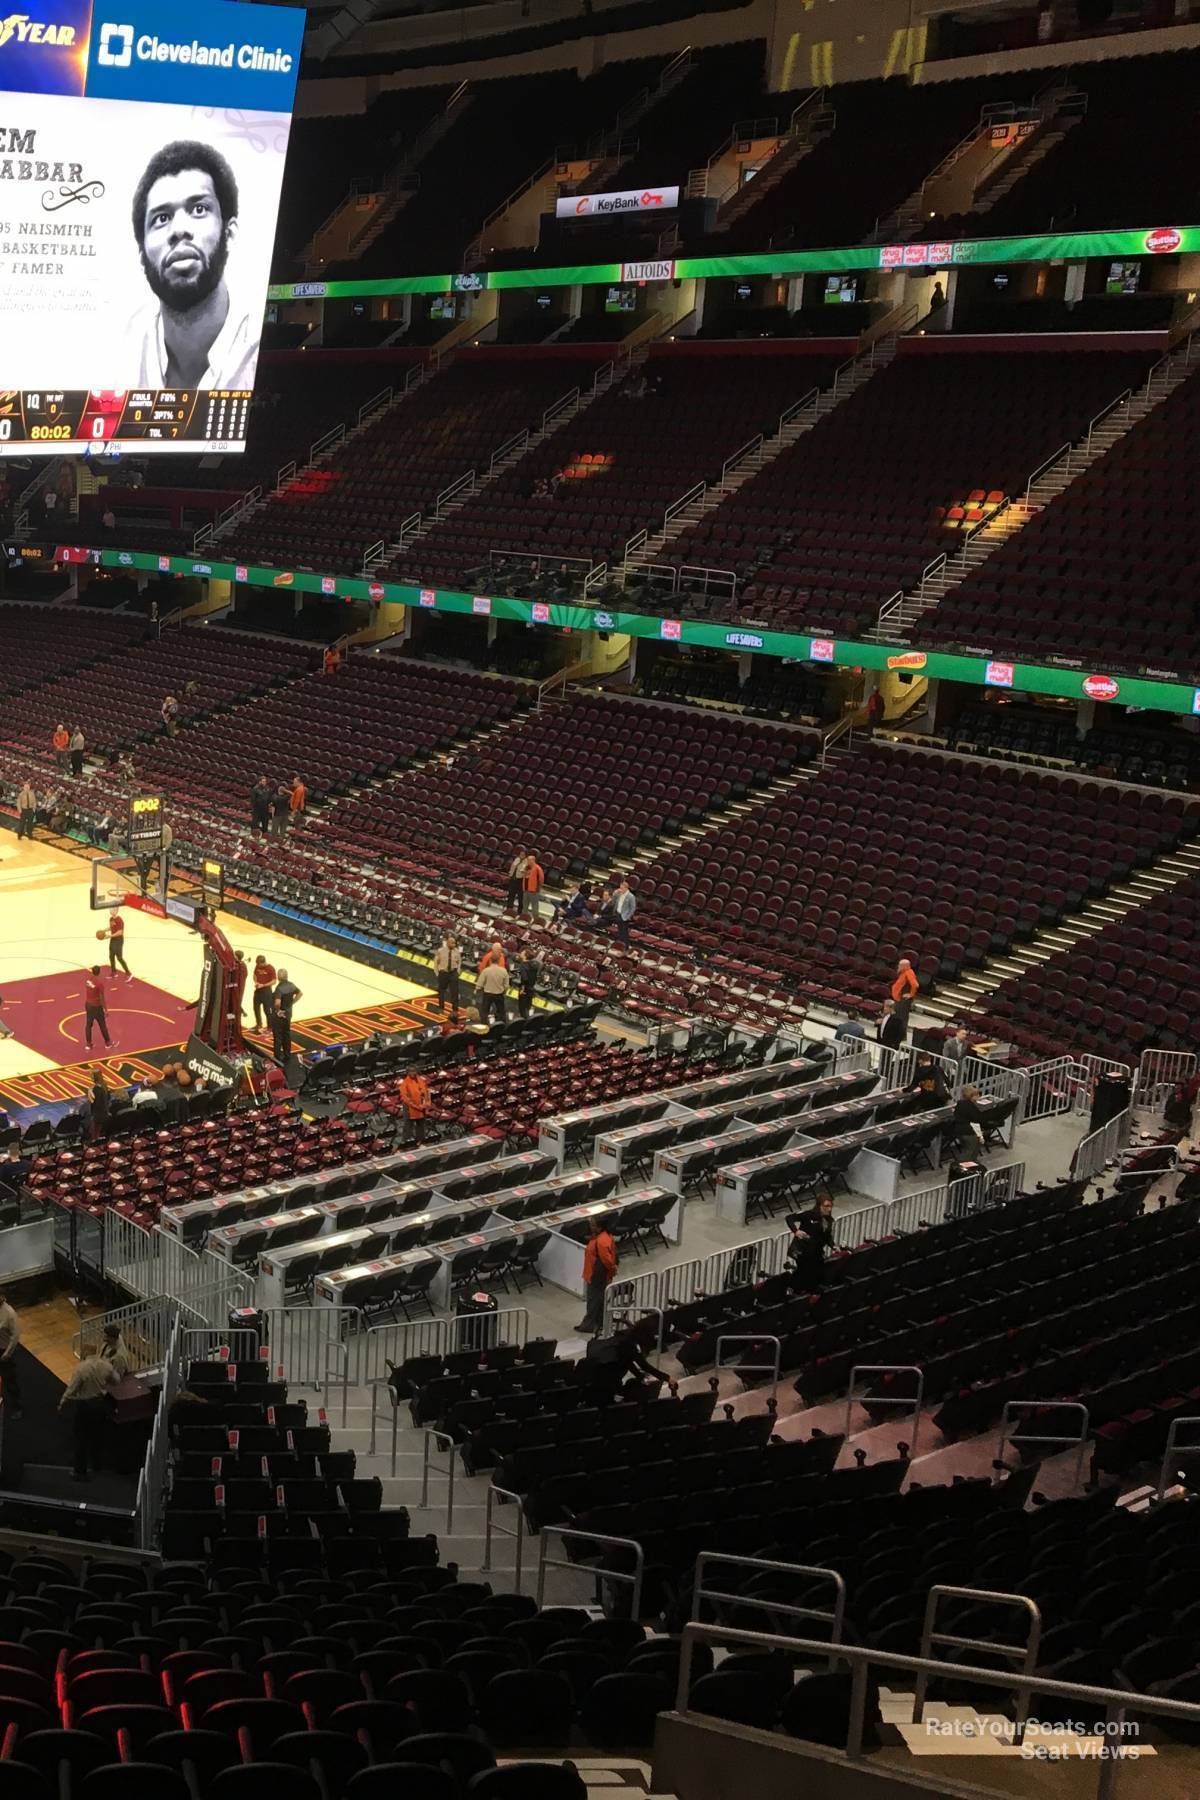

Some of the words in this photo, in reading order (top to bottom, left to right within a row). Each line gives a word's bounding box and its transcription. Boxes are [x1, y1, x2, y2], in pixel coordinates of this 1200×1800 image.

[137, 36, 233, 67] Cleveland
[238, 44, 293, 74] Clinic
[598, 197, 640, 212] KeyBank
[18, 223, 93, 237] NAISMITH
[2, 243, 97, 257] BASKETBALL
[12, 263, 64, 275] FAMER
[626, 262, 670, 280] ALTOIDS
[27, 394, 40, 409] 1Q
[31, 425, 72, 440] 80:02
[92, 417, 105, 438] 0
[188, 1058, 211, 1078] drug
